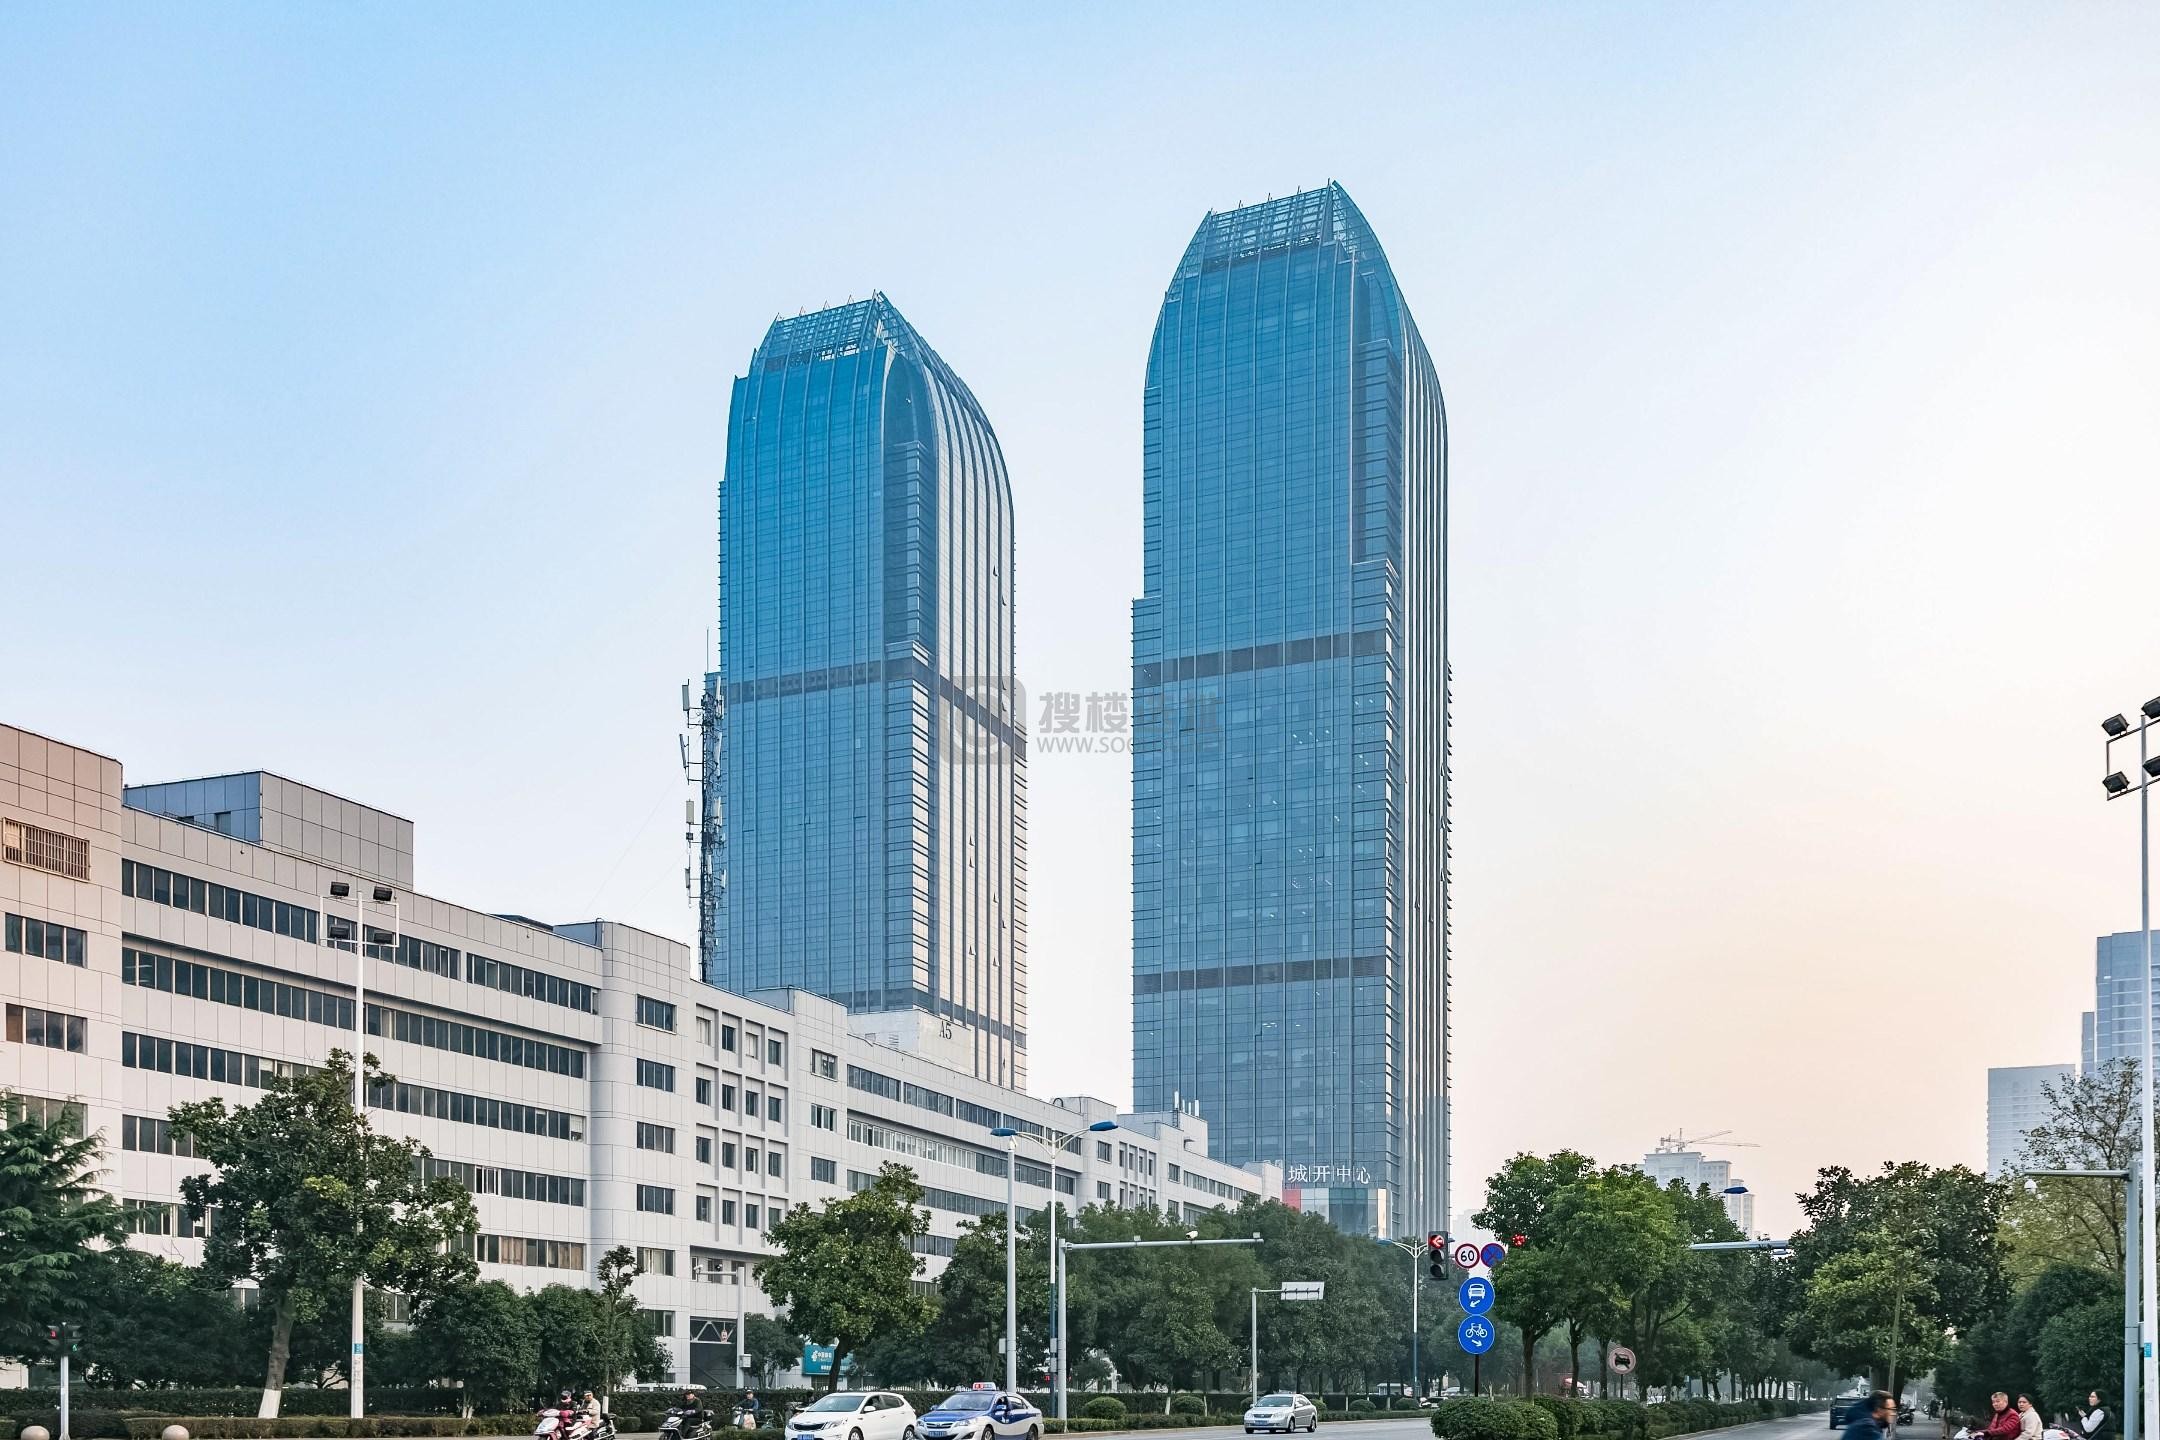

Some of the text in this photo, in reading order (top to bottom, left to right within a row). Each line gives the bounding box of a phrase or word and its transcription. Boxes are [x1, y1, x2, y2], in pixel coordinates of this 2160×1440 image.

[939, 1021, 952, 1039] A5
[1288, 1164, 1371, 1184] 城开中心
[1460, 1250, 1475, 1262] 60
